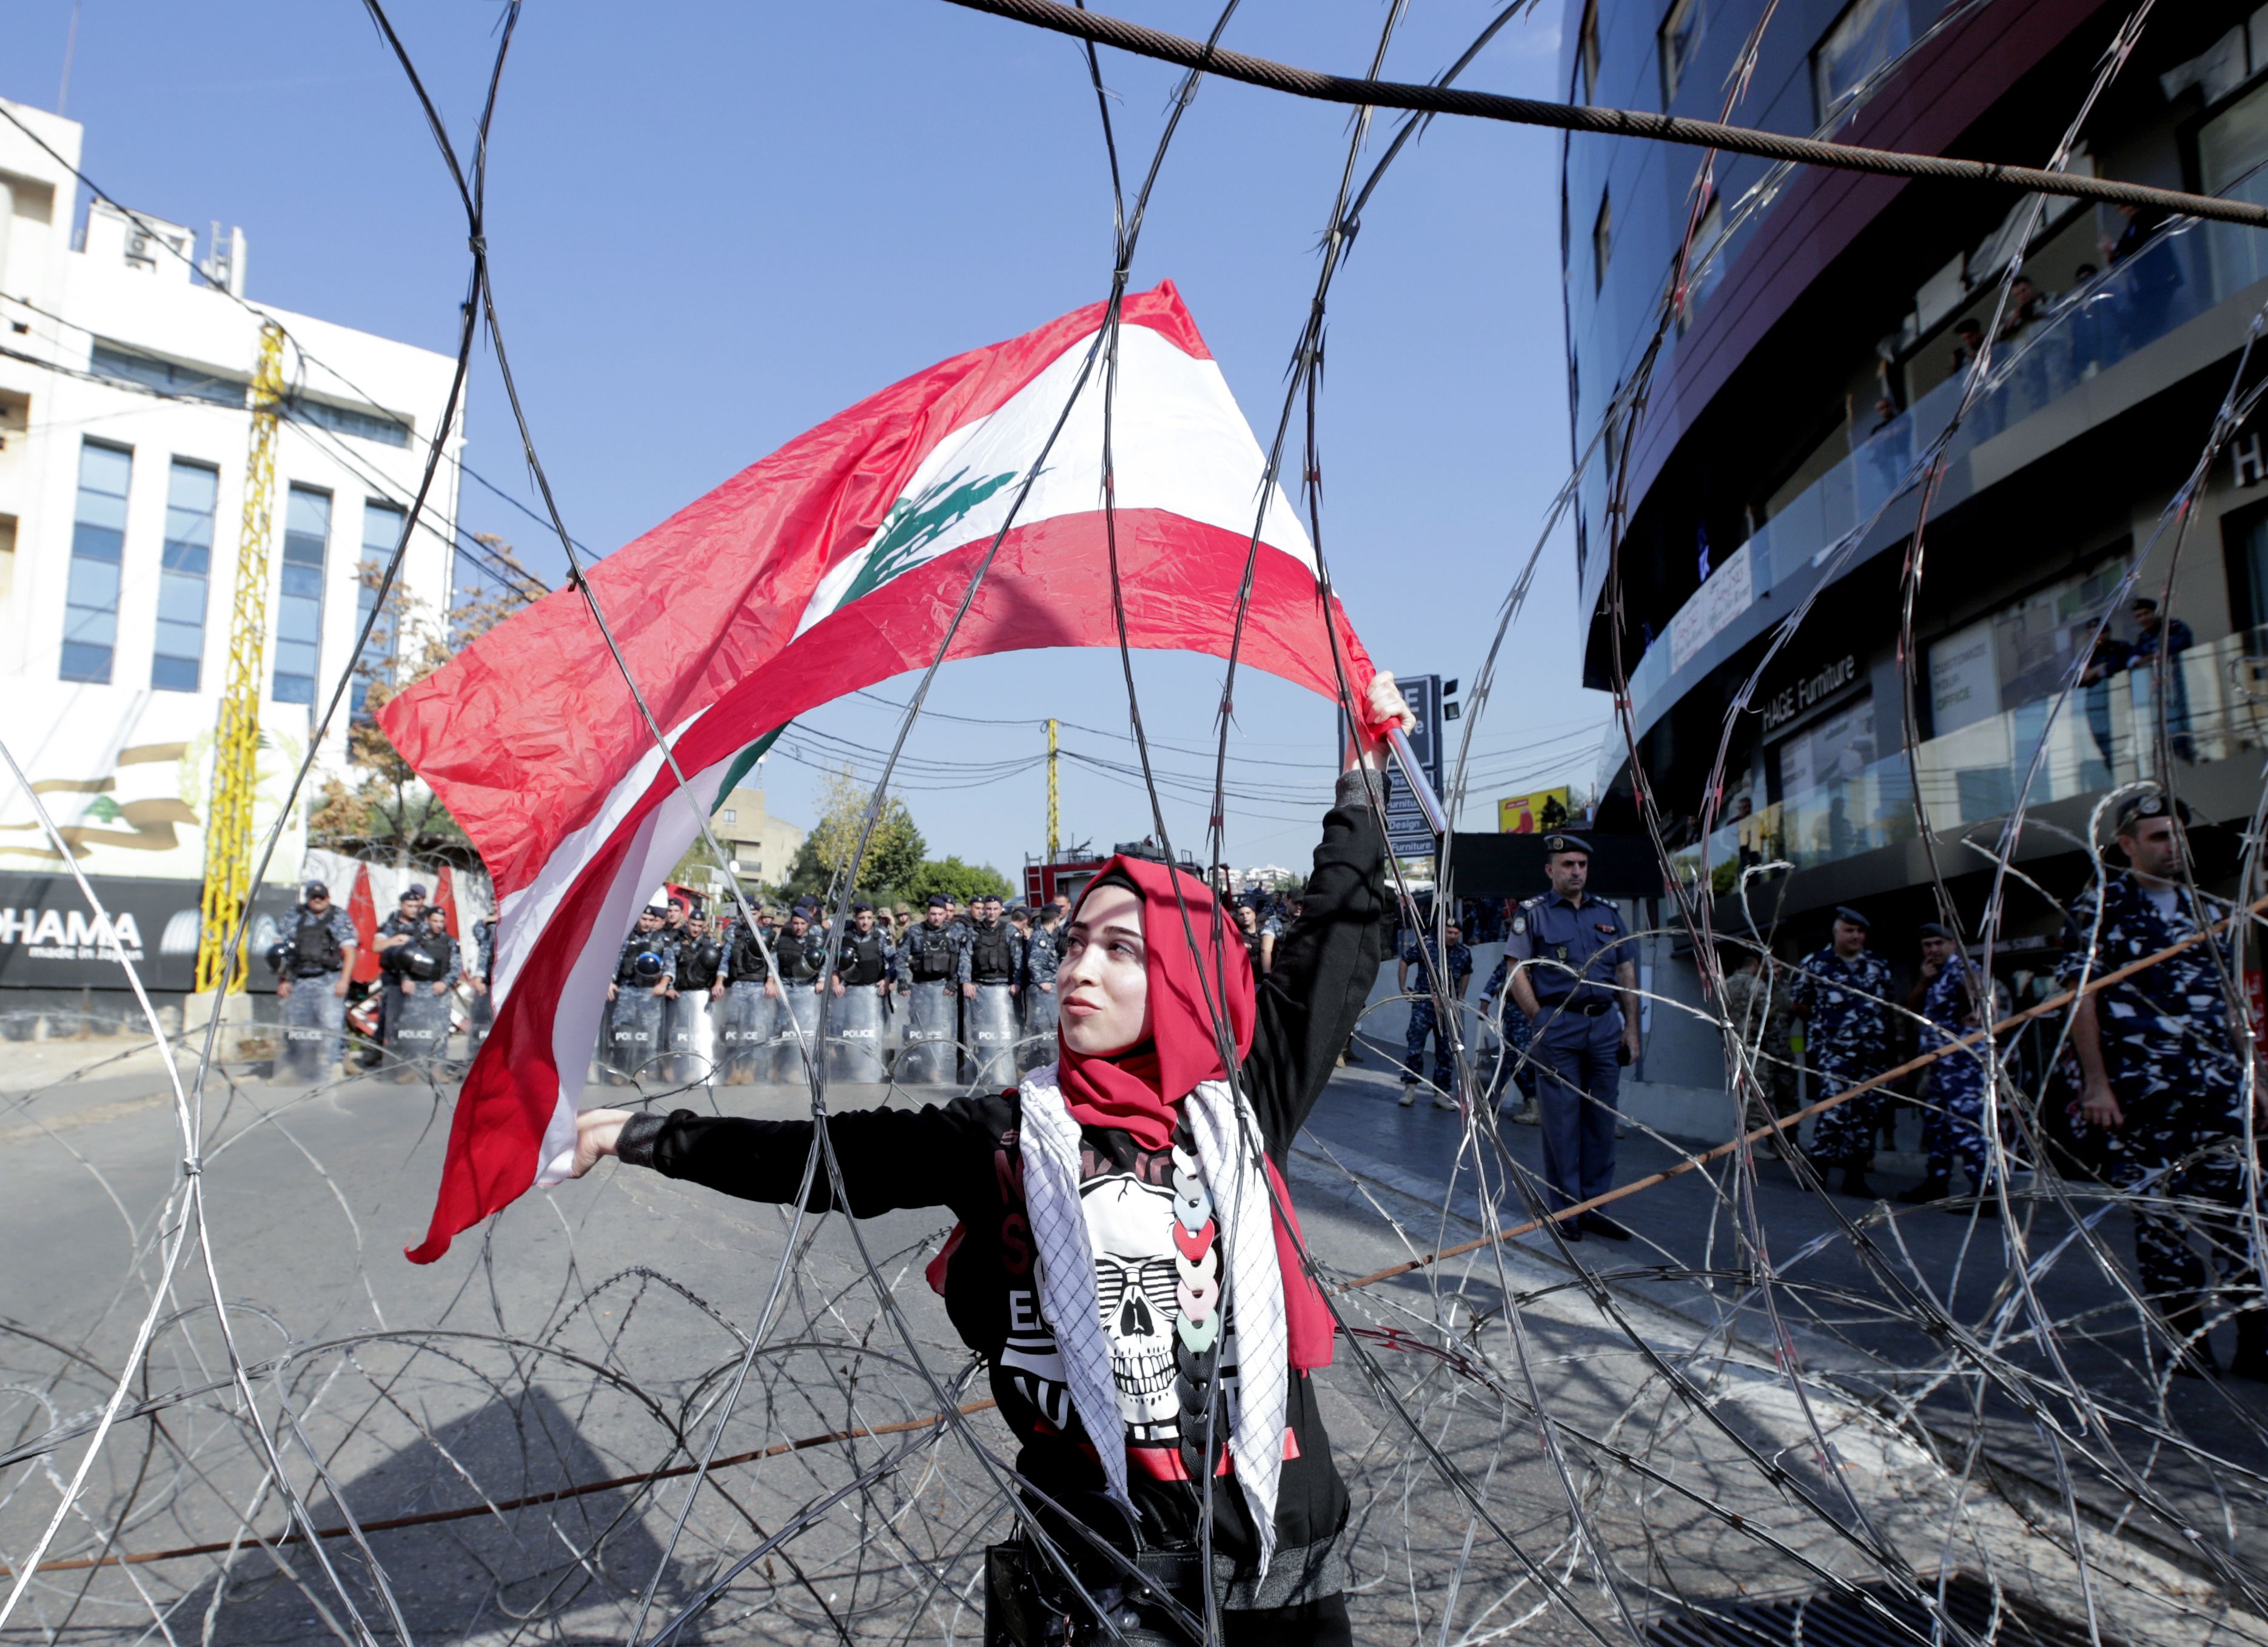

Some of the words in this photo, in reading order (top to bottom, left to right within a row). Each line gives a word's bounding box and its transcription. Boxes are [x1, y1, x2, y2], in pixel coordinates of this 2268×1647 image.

[1763, 686, 1795, 732] HAGE
[1798, 654, 1854, 709] Furniture
[1935, 686, 1972, 710] OFFICE
[1389, 820, 1420, 830] Design
[1392, 842, 1432, 852] Furniture
[0, 907, 143, 948] HAMA
[28, 946, 76, 959] made
[78, 946, 95, 960] in
[288, 1030, 322, 1041] POLICE
[398, 1030, 432, 1039] POLICE
[842, 1029, 876, 1039] POLICE
